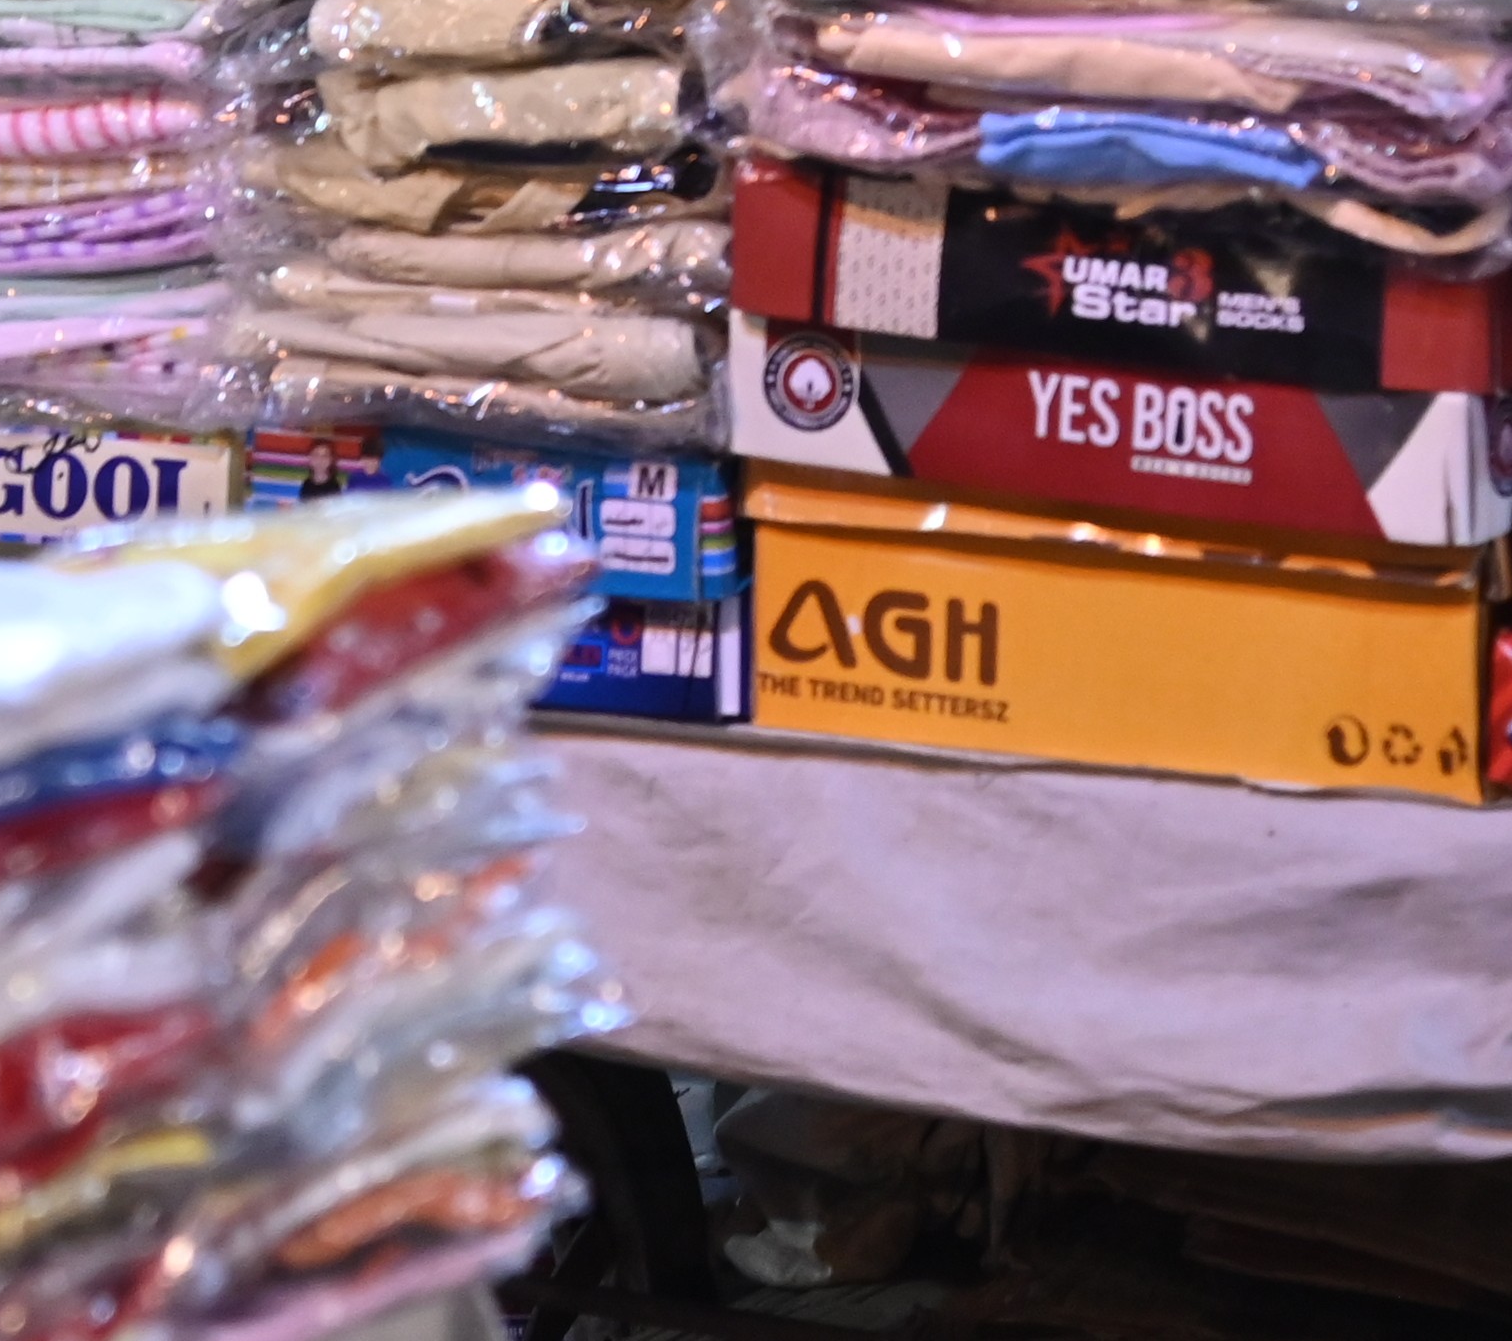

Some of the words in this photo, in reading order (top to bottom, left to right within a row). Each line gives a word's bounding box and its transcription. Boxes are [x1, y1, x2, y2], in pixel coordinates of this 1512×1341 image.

[1062, 255, 1169, 293] UMAR
[1071, 283, 1198, 327] Star
[1028, 369, 1121, 448] YES
[1131, 381, 1254, 464] BOSS
[637, 467, 666, 498] M
[768, 579, 999, 687] AGH
[756, 672, 800, 698] THE
[808, 678, 885, 708] TREND
[891, 687, 1011, 724] SETTERSZ
